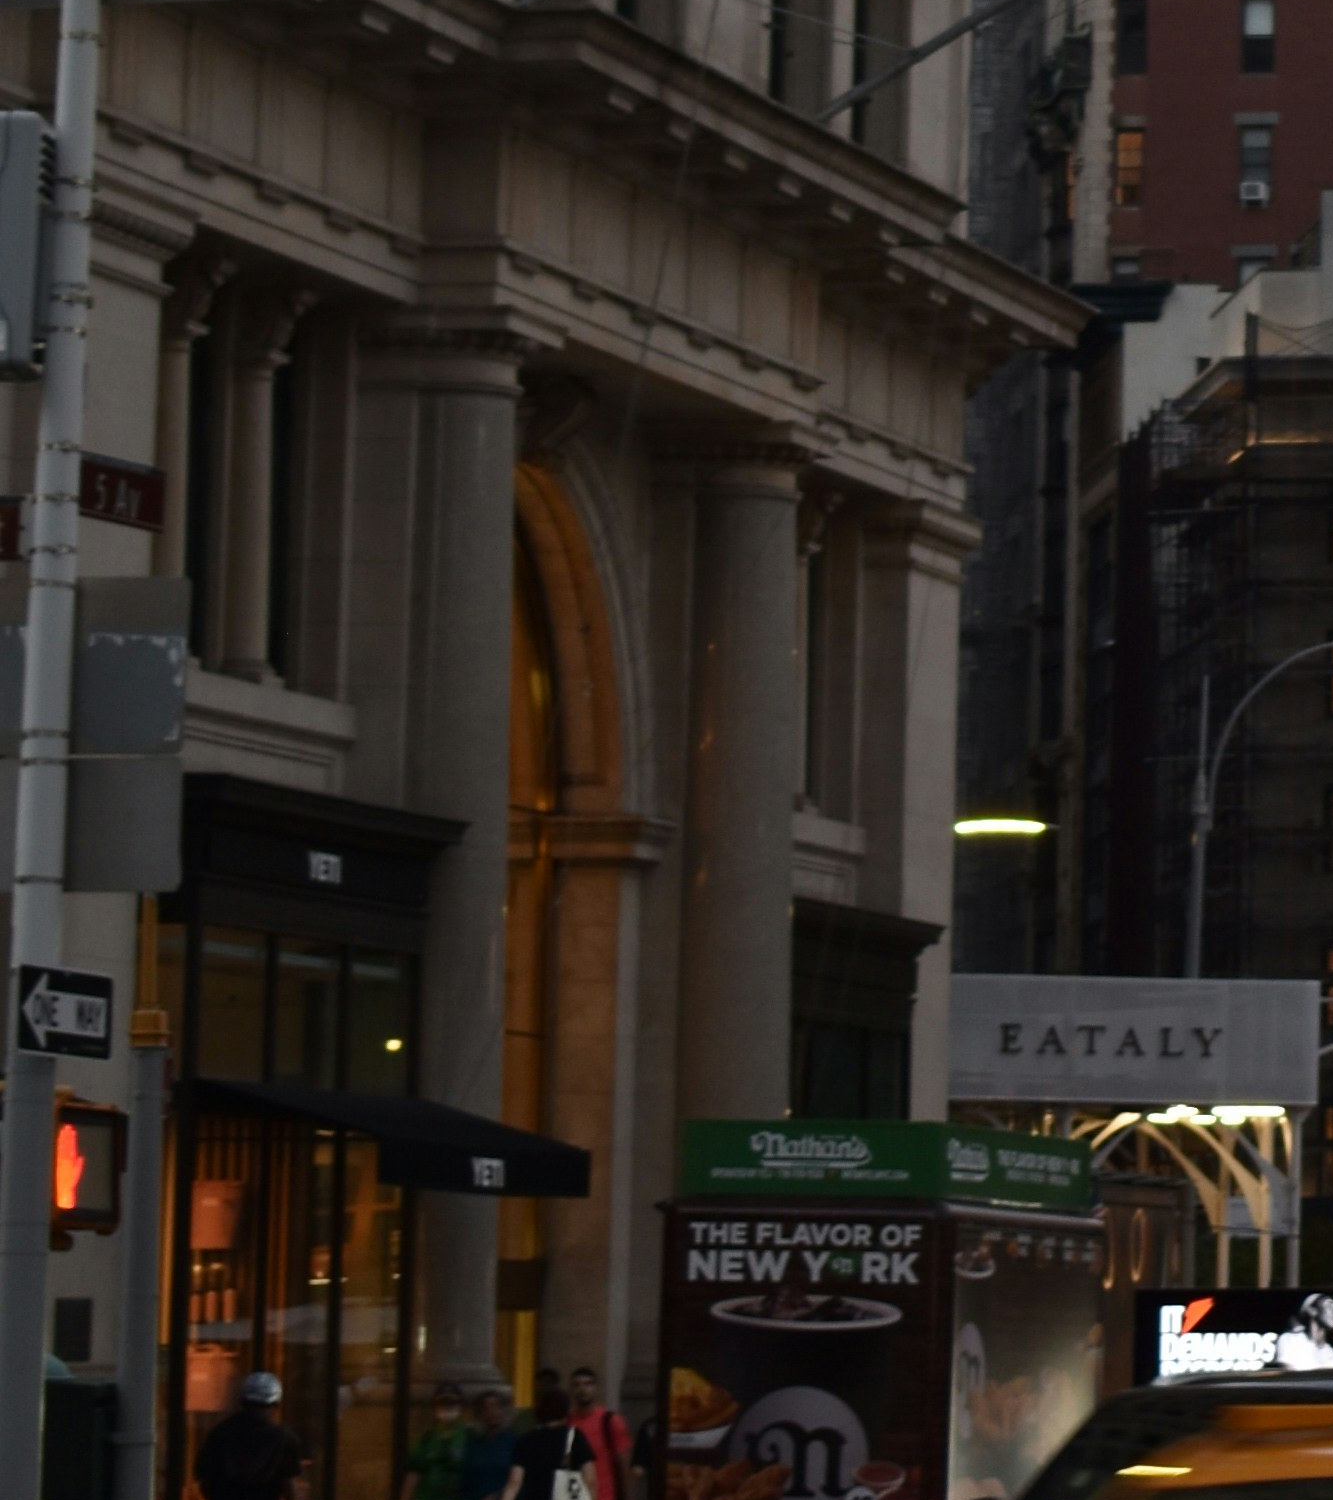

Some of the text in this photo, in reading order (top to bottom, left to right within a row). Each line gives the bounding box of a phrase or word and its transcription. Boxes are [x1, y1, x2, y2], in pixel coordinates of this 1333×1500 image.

[308, 850, 343, 885] YETI
[33, 992, 103, 1033] ONE WAY
[998, 1022, 1226, 1060] EATALY
[471, 1156, 506, 1189] YETI
[689, 1221, 923, 1248] THE FLAVOR OF
[686, 1249, 790, 1282] NEW
[1160, 1304, 1186, 1334] IT
[1160, 1332, 1278, 1363] DEMANDS
